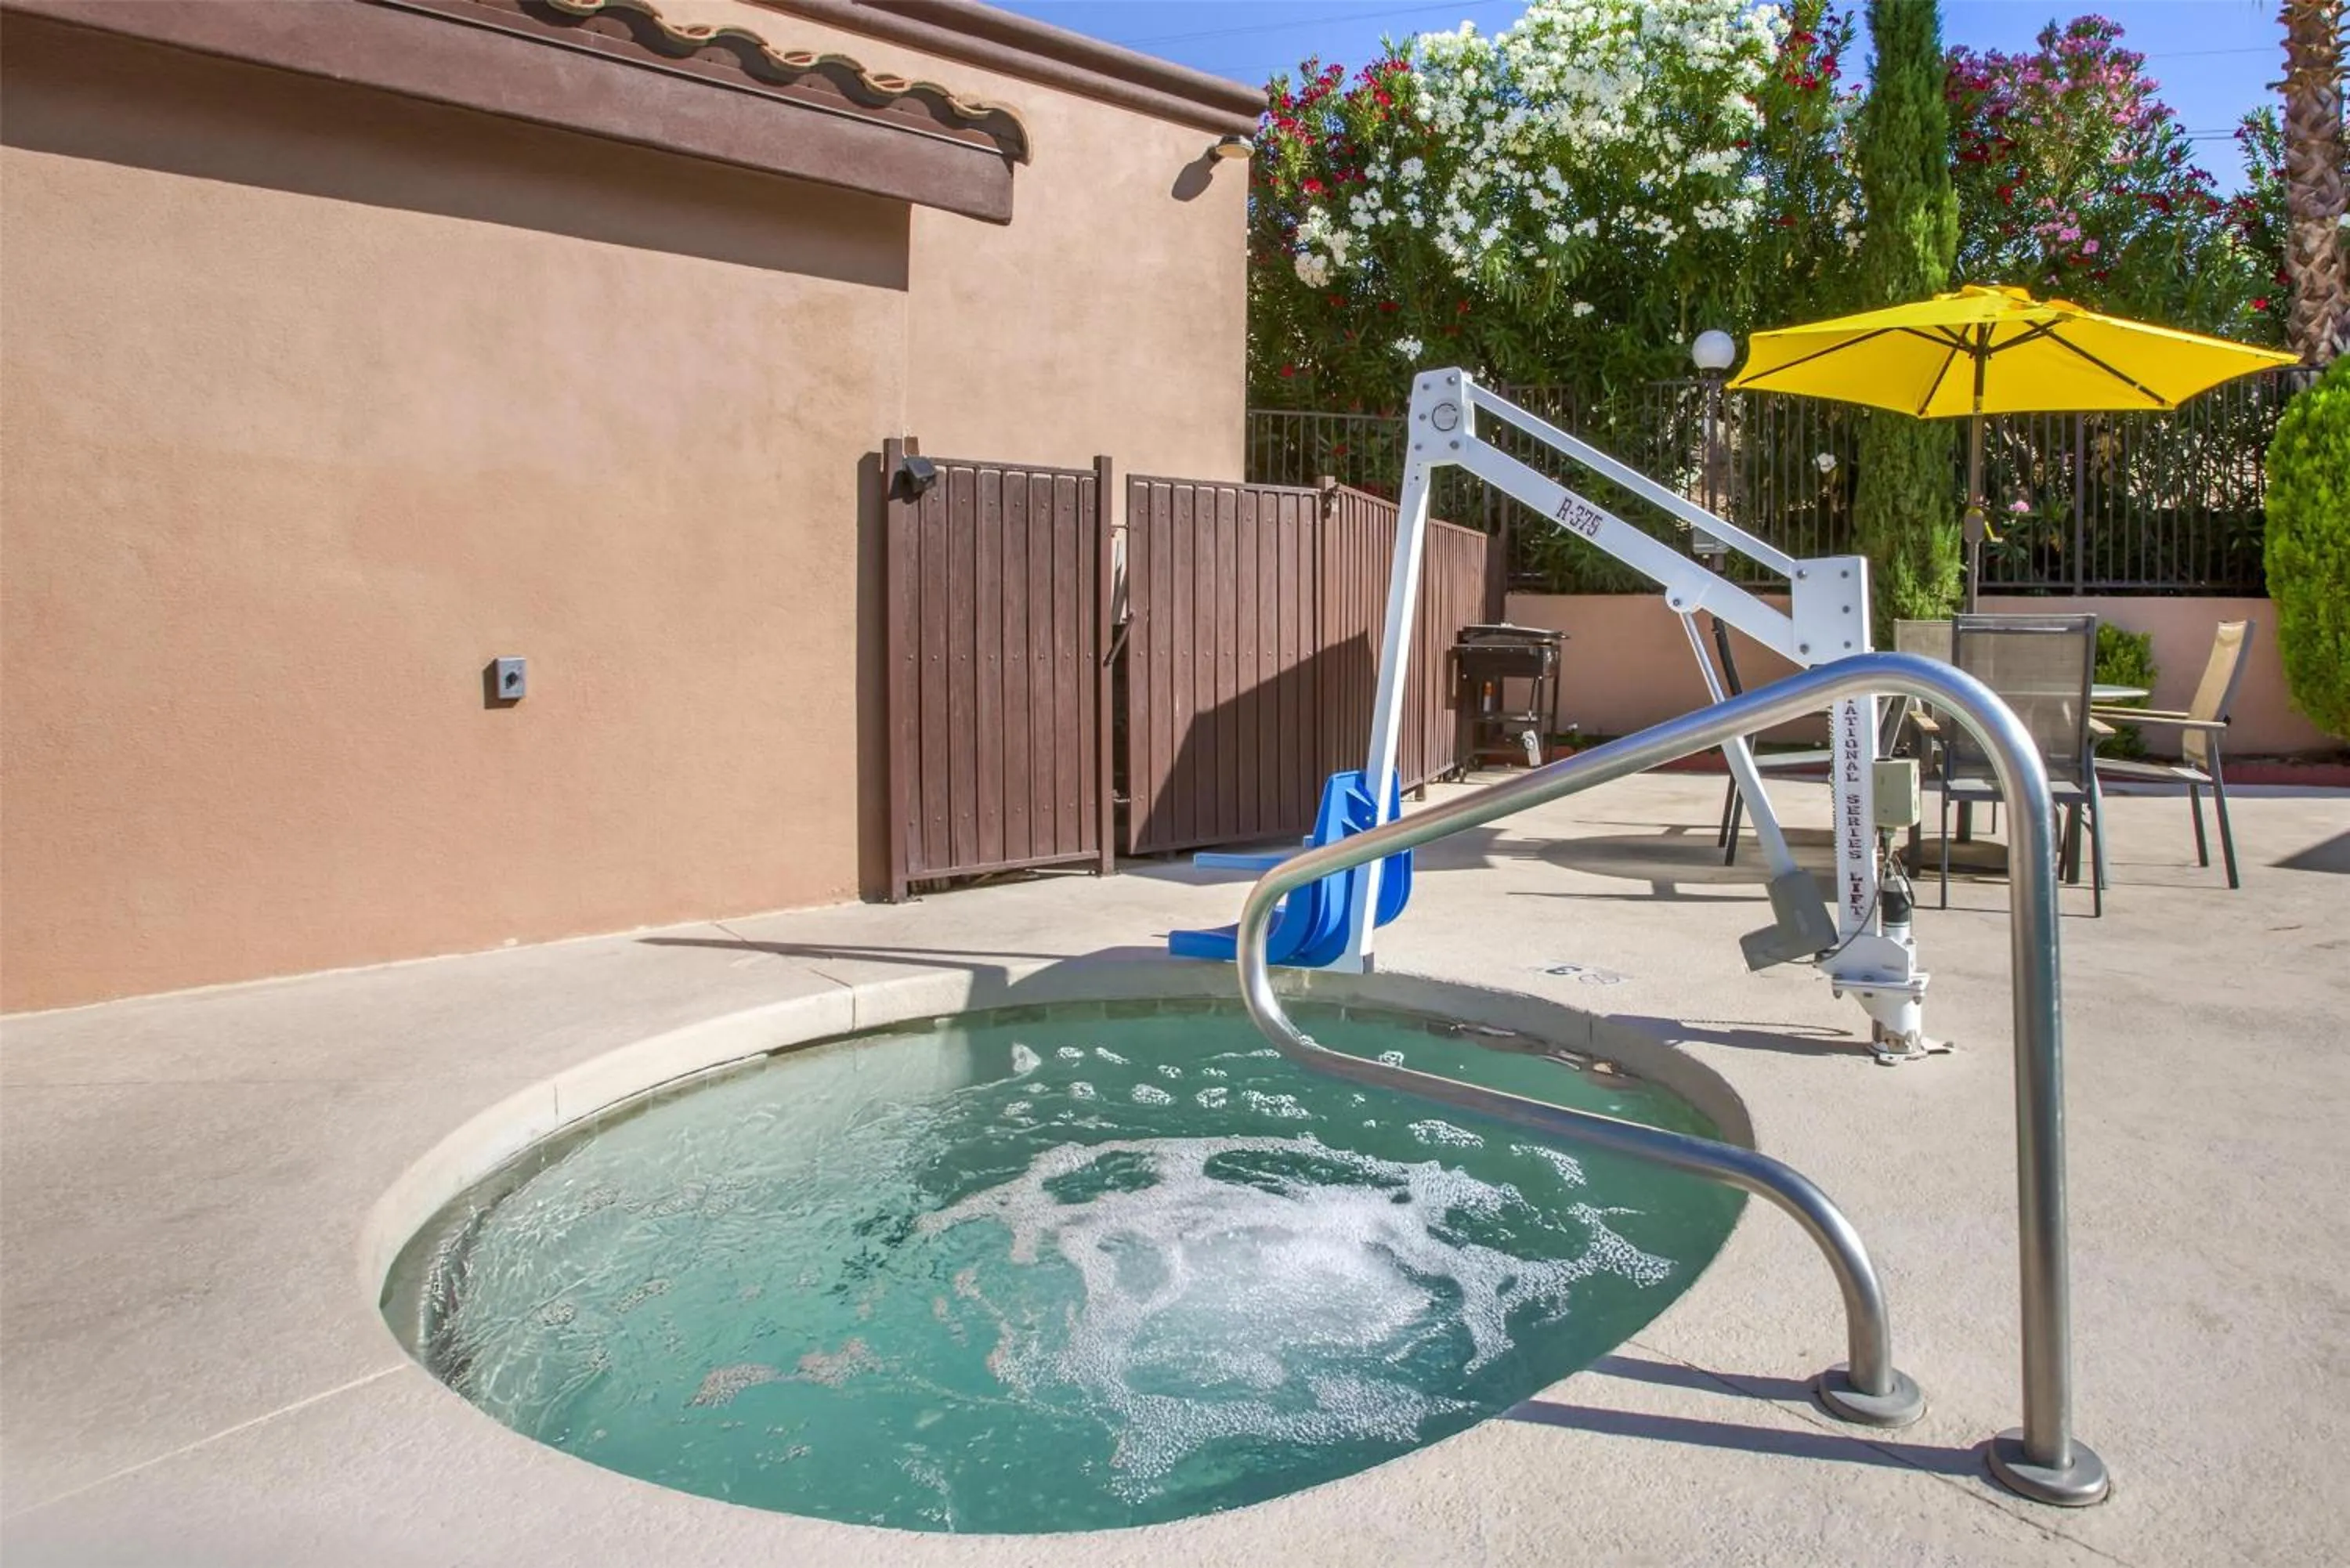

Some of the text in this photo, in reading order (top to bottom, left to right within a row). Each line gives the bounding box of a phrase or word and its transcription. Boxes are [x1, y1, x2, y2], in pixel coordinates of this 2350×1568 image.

[1556, 496, 1603, 537] R-375
[1846, 793, 1862, 859] SERIES
[1849, 872, 1864, 916] LIFT
